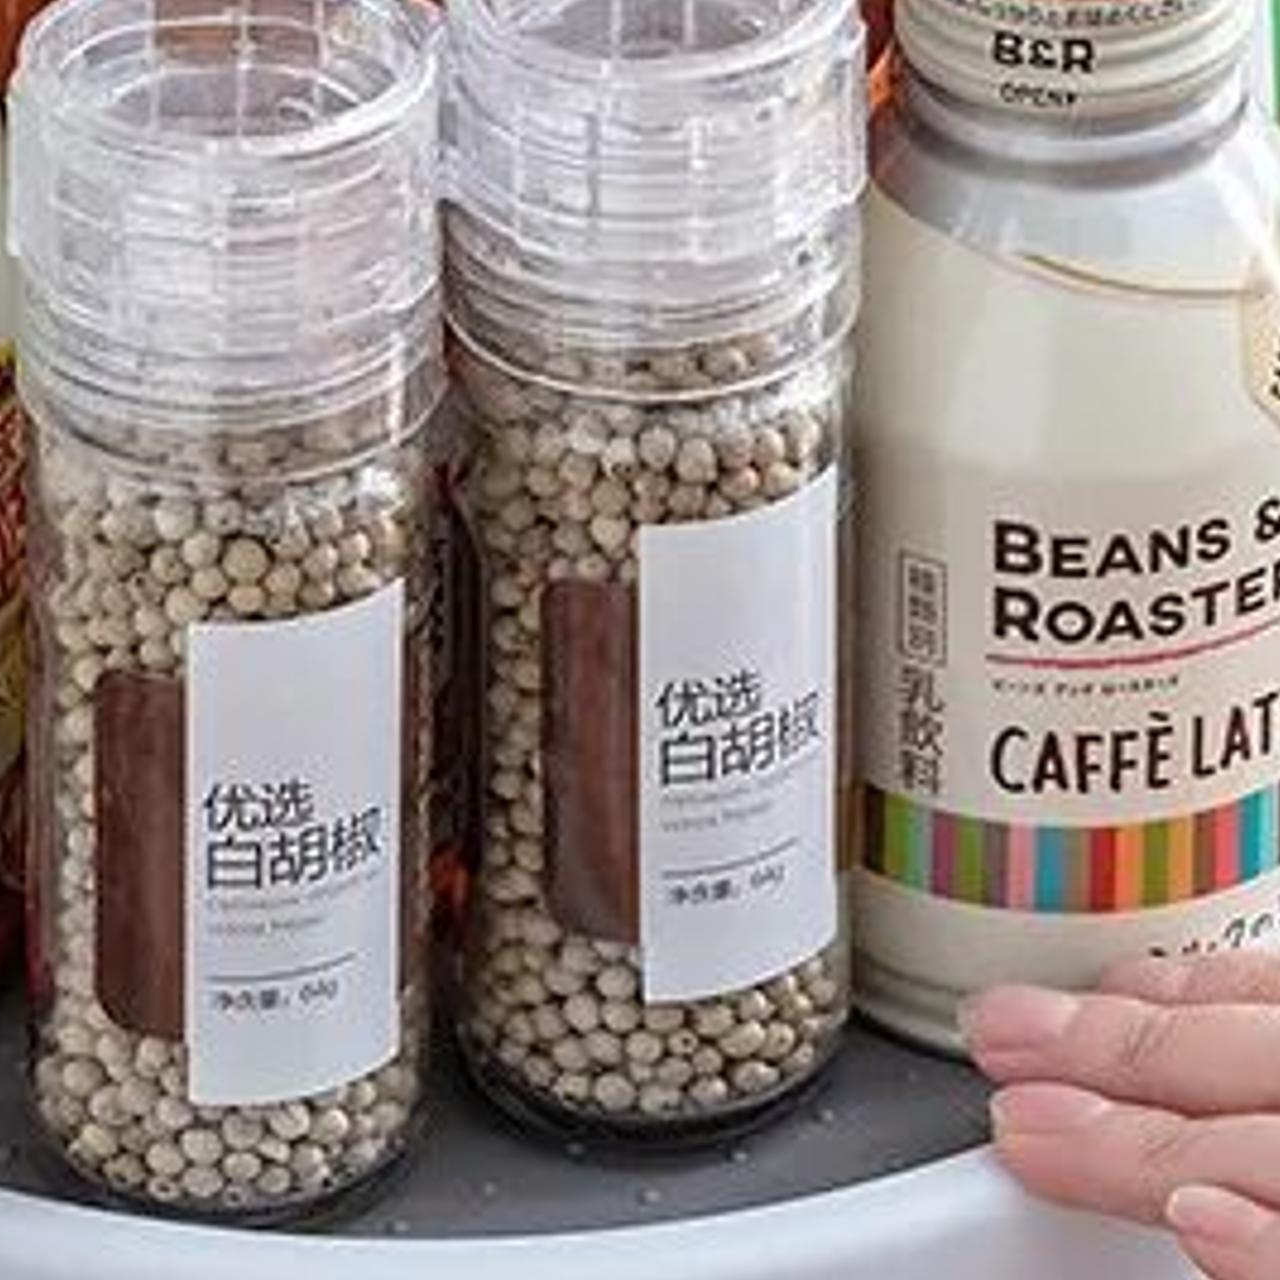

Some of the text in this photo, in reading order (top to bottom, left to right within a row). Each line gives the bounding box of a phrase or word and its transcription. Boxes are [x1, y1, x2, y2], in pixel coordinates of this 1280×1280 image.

[993, 516, 1232, 579] BEANS
[655, 668, 762, 728] 优选
[660, 690, 819, 786] 白胡椒
[991, 711, 1175, 795] CAFFÈ
[202, 778, 316, 832] 优选
[206, 806, 382, 889] 白胡椒
